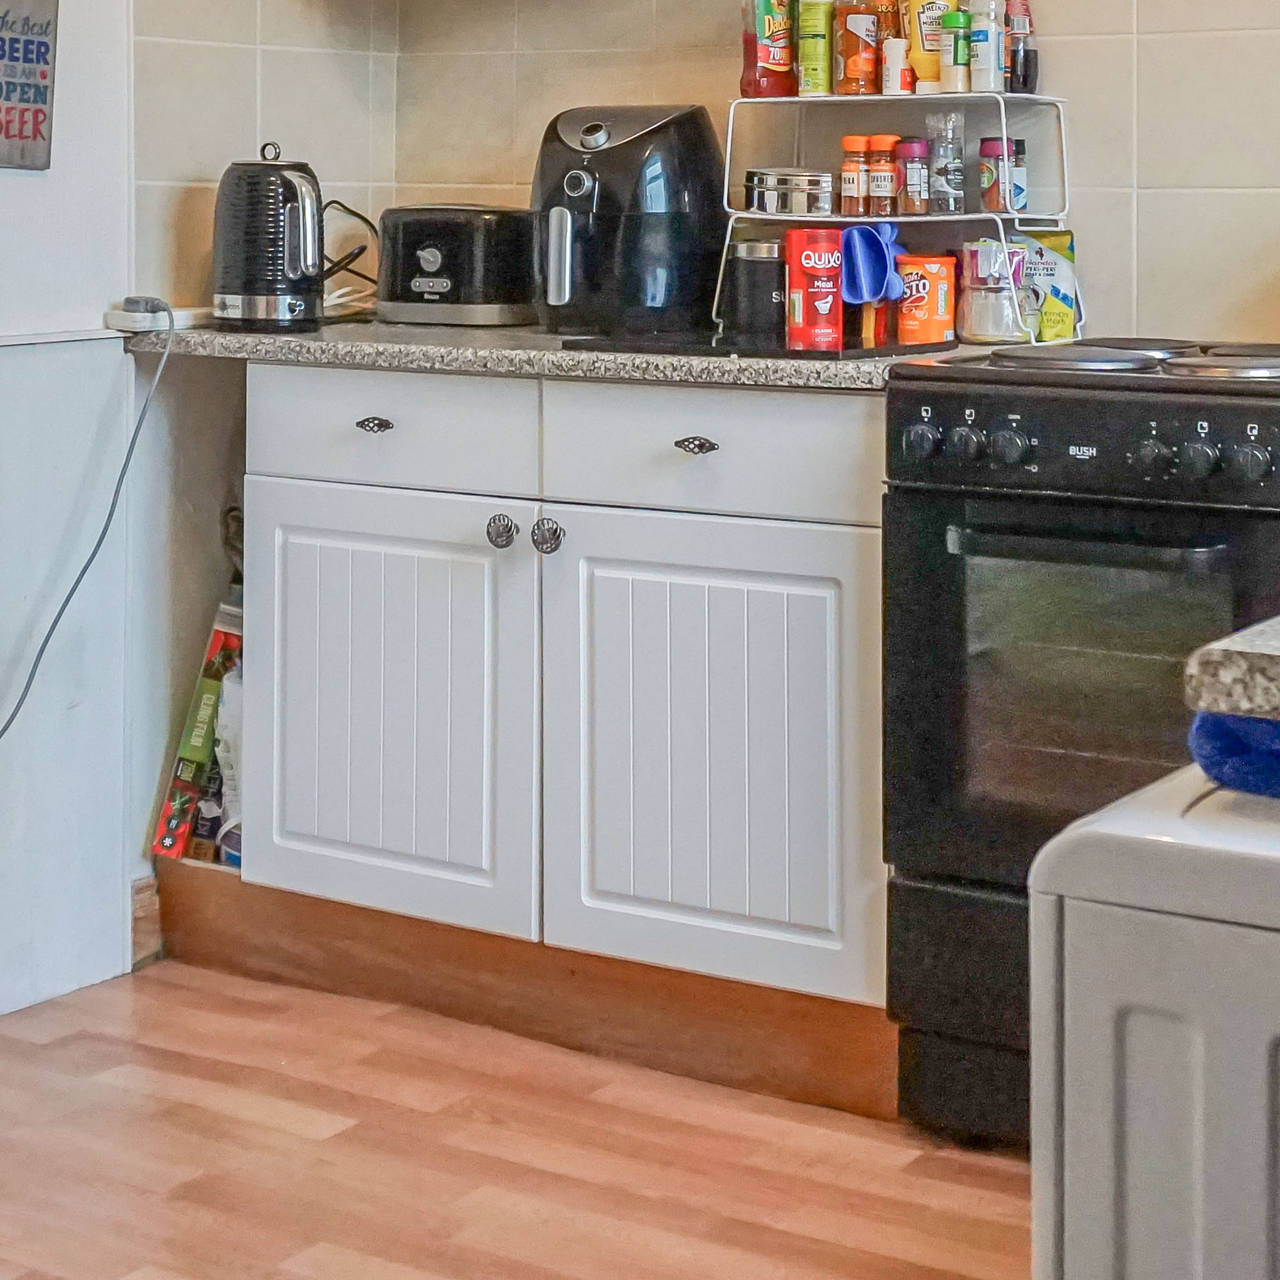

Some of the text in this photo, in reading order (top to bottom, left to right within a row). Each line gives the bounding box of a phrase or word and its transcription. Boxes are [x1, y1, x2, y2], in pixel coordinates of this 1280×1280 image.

[925, 4, 946, 13] HEINZ
[903, 279, 930, 298] STO
[1068, 445, 1097, 457] BUSH
